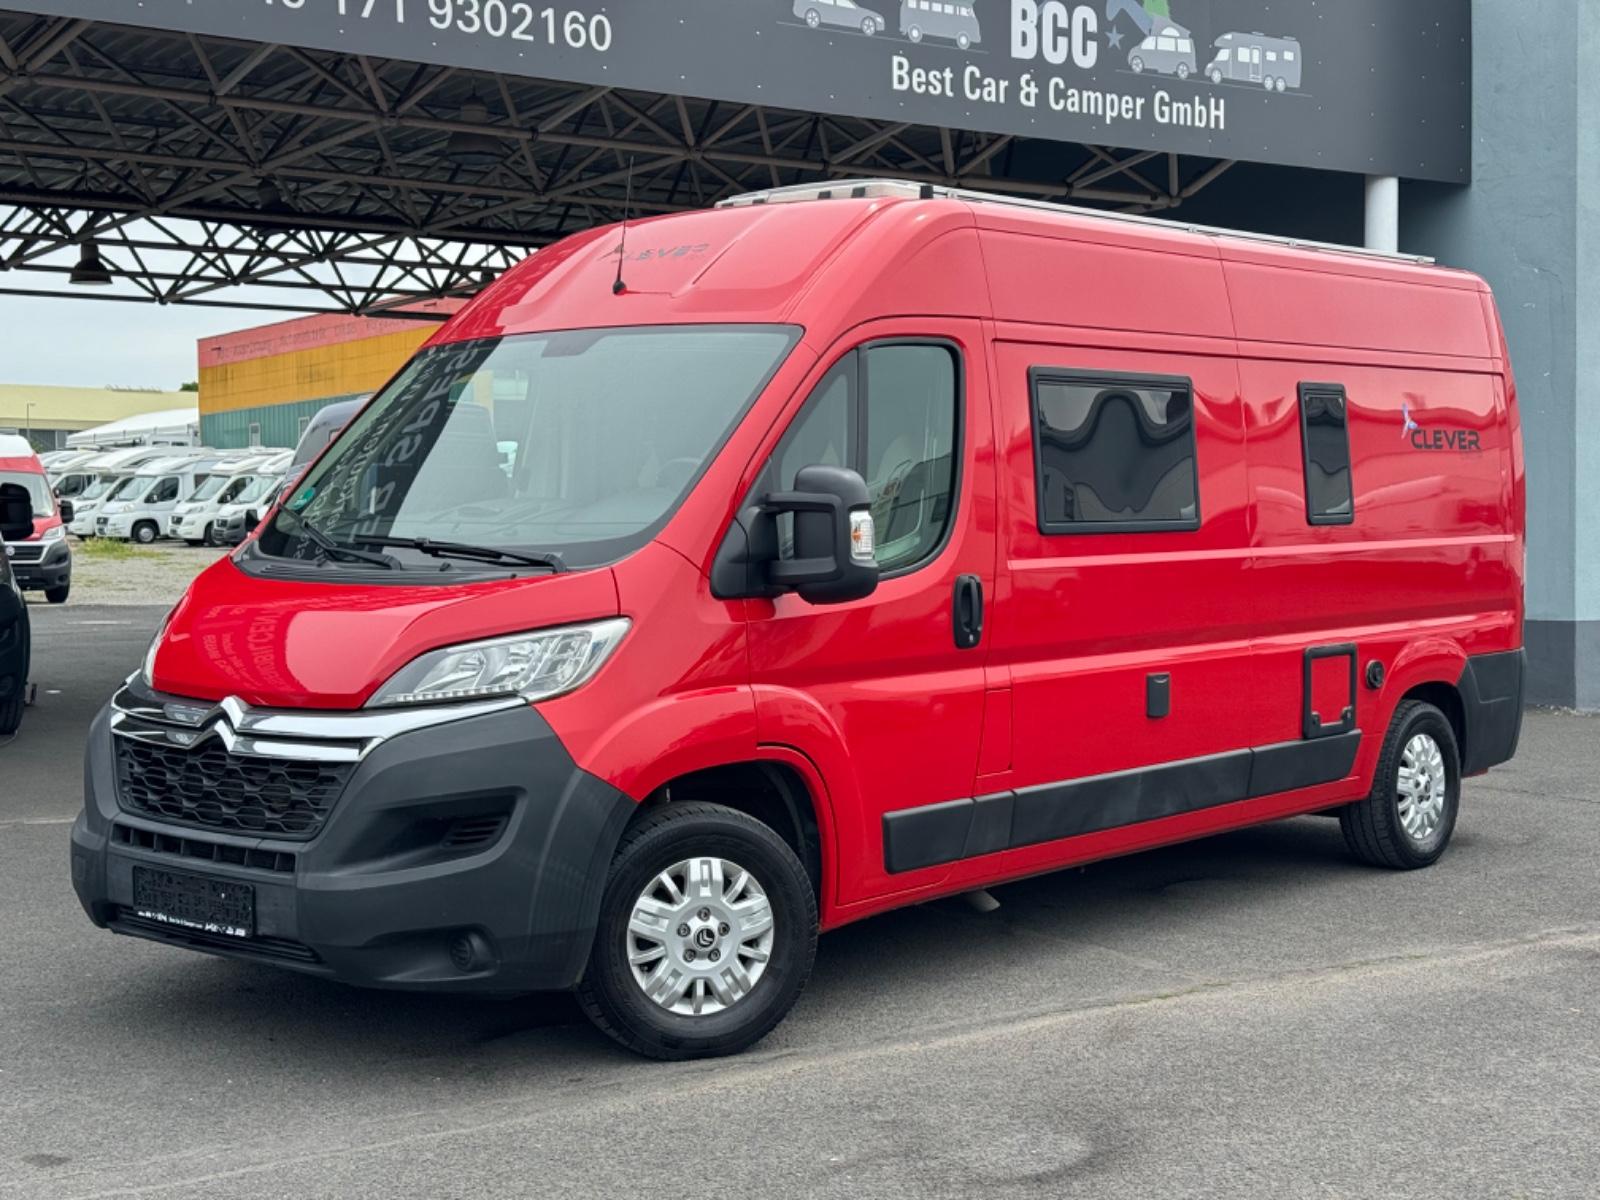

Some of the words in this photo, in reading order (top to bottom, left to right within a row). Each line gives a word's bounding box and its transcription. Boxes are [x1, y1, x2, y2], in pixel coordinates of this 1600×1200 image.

[428, 0, 612, 52] 9302160
[1010, 0, 1098, 69] BCC
[892, 55, 955, 98] Best
[963, 65, 1009, 104] Car
[1019, 73, 1039, 108] &
[1048, 76, 1146, 125] Camper
[1153, 90, 1226, 130] GmbH
[1410, 428, 1481, 450] CLEVER
